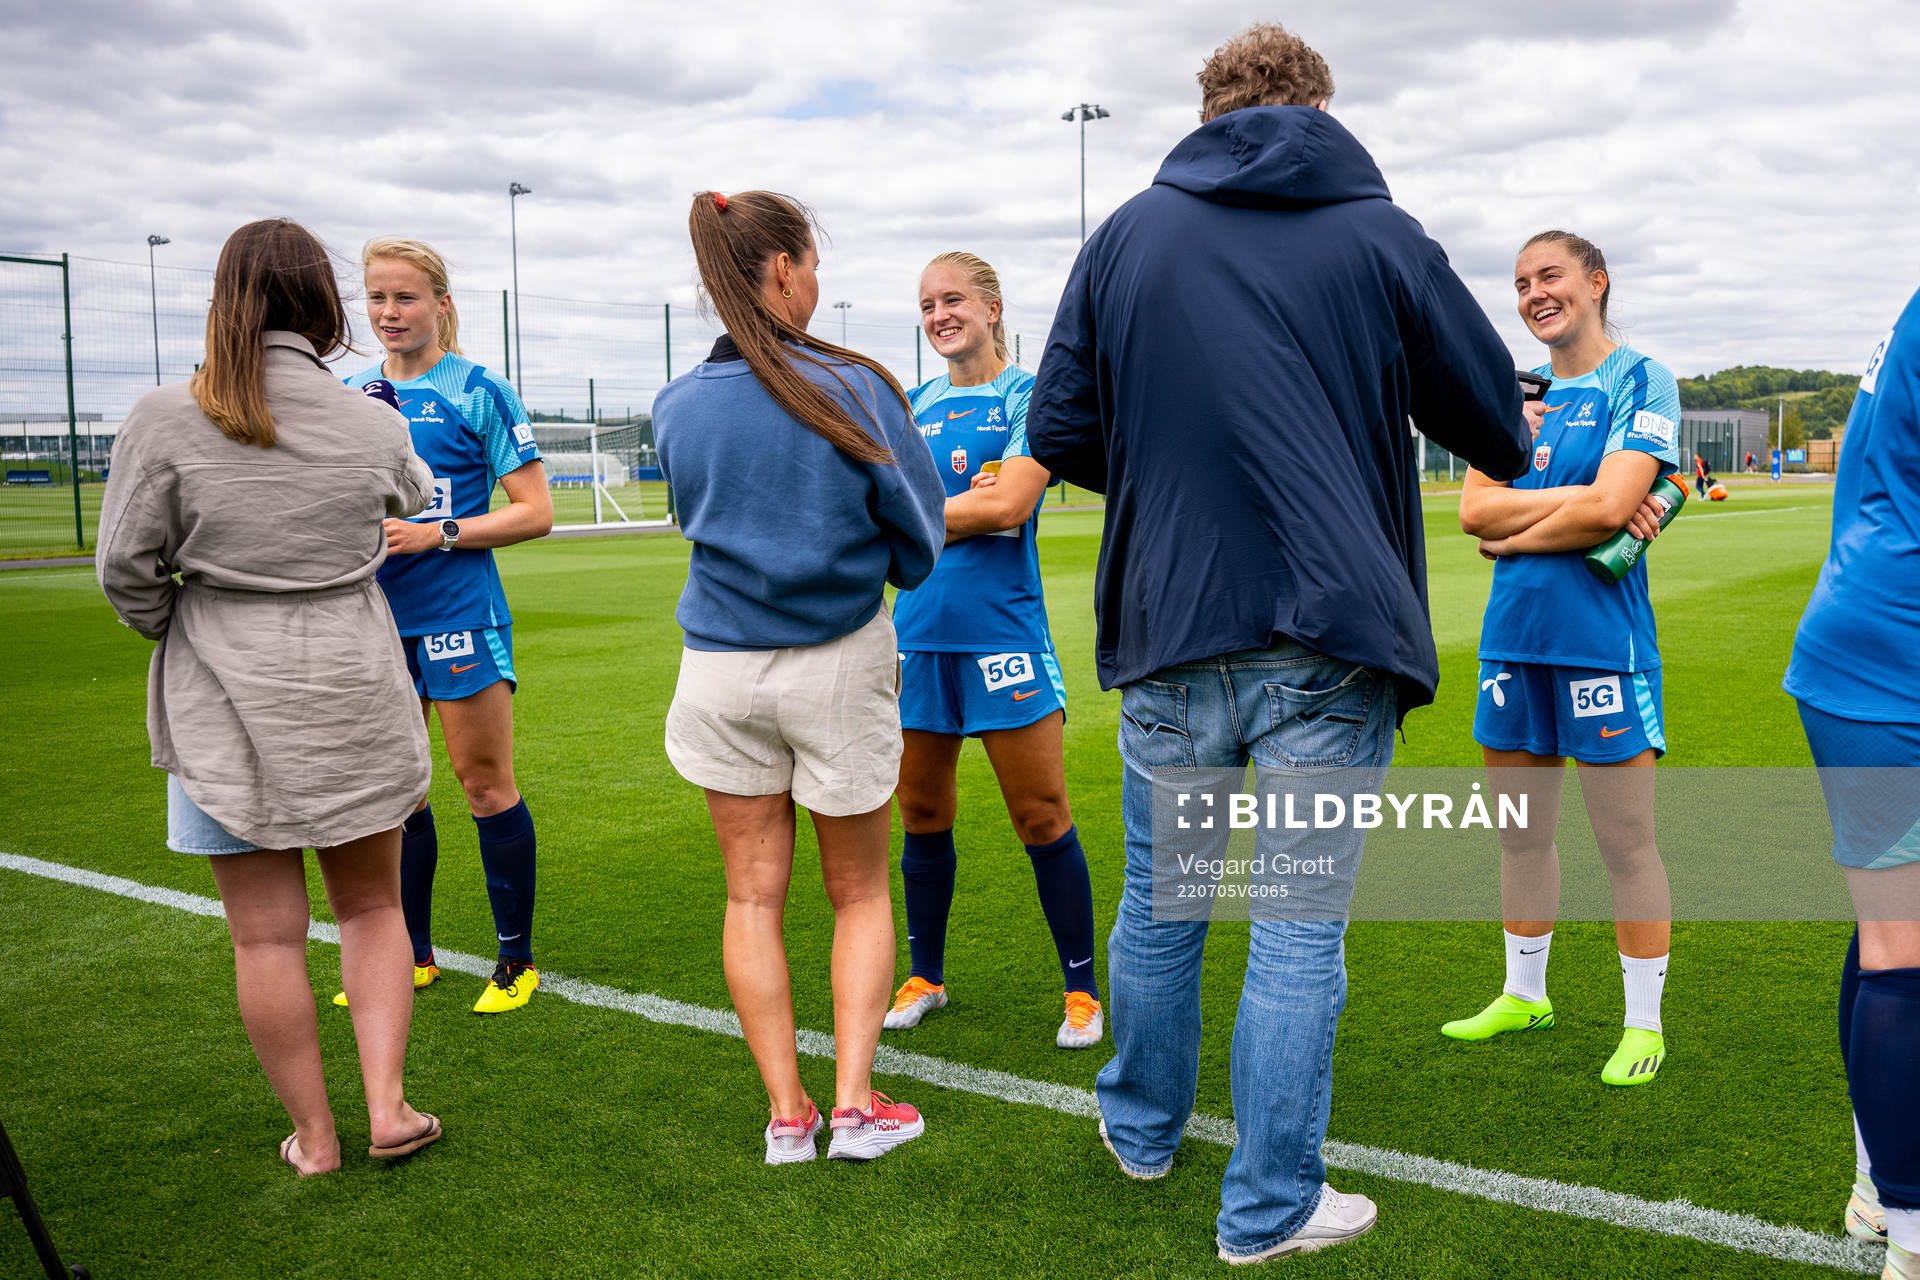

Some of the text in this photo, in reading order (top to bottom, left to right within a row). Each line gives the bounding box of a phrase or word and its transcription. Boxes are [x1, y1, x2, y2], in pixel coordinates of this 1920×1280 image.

[1639, 415, 1668, 435] DNB
[431, 631, 465, 653] 5G
[988, 655, 1026, 683] 5G
[1577, 684, 1614, 710] 5G
